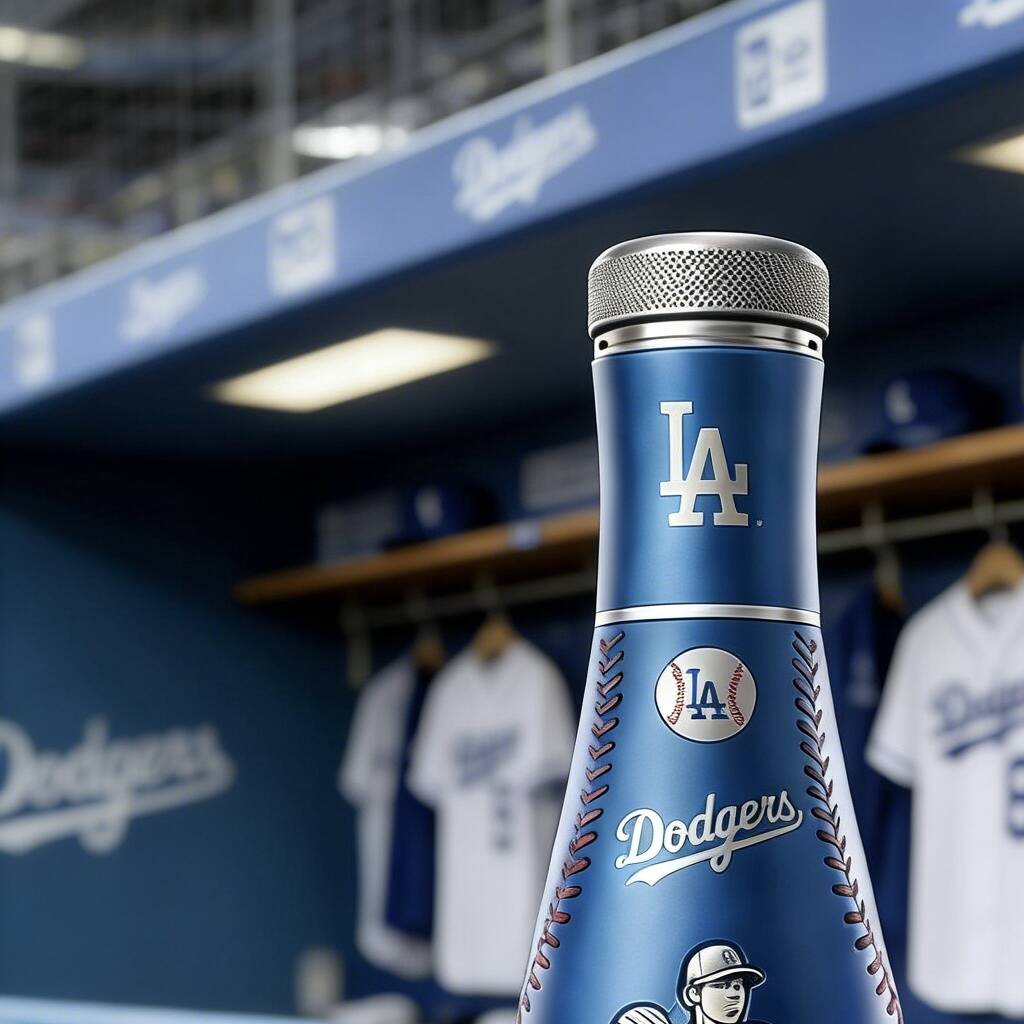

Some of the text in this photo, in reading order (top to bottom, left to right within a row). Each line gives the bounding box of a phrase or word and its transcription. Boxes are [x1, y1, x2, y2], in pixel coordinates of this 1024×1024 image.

[660, 401, 749, 528] LA
[686, 668, 726, 720] LA
[0, 716, 237, 857] Dodgers
[614, 789, 804, 887] Dodgers
